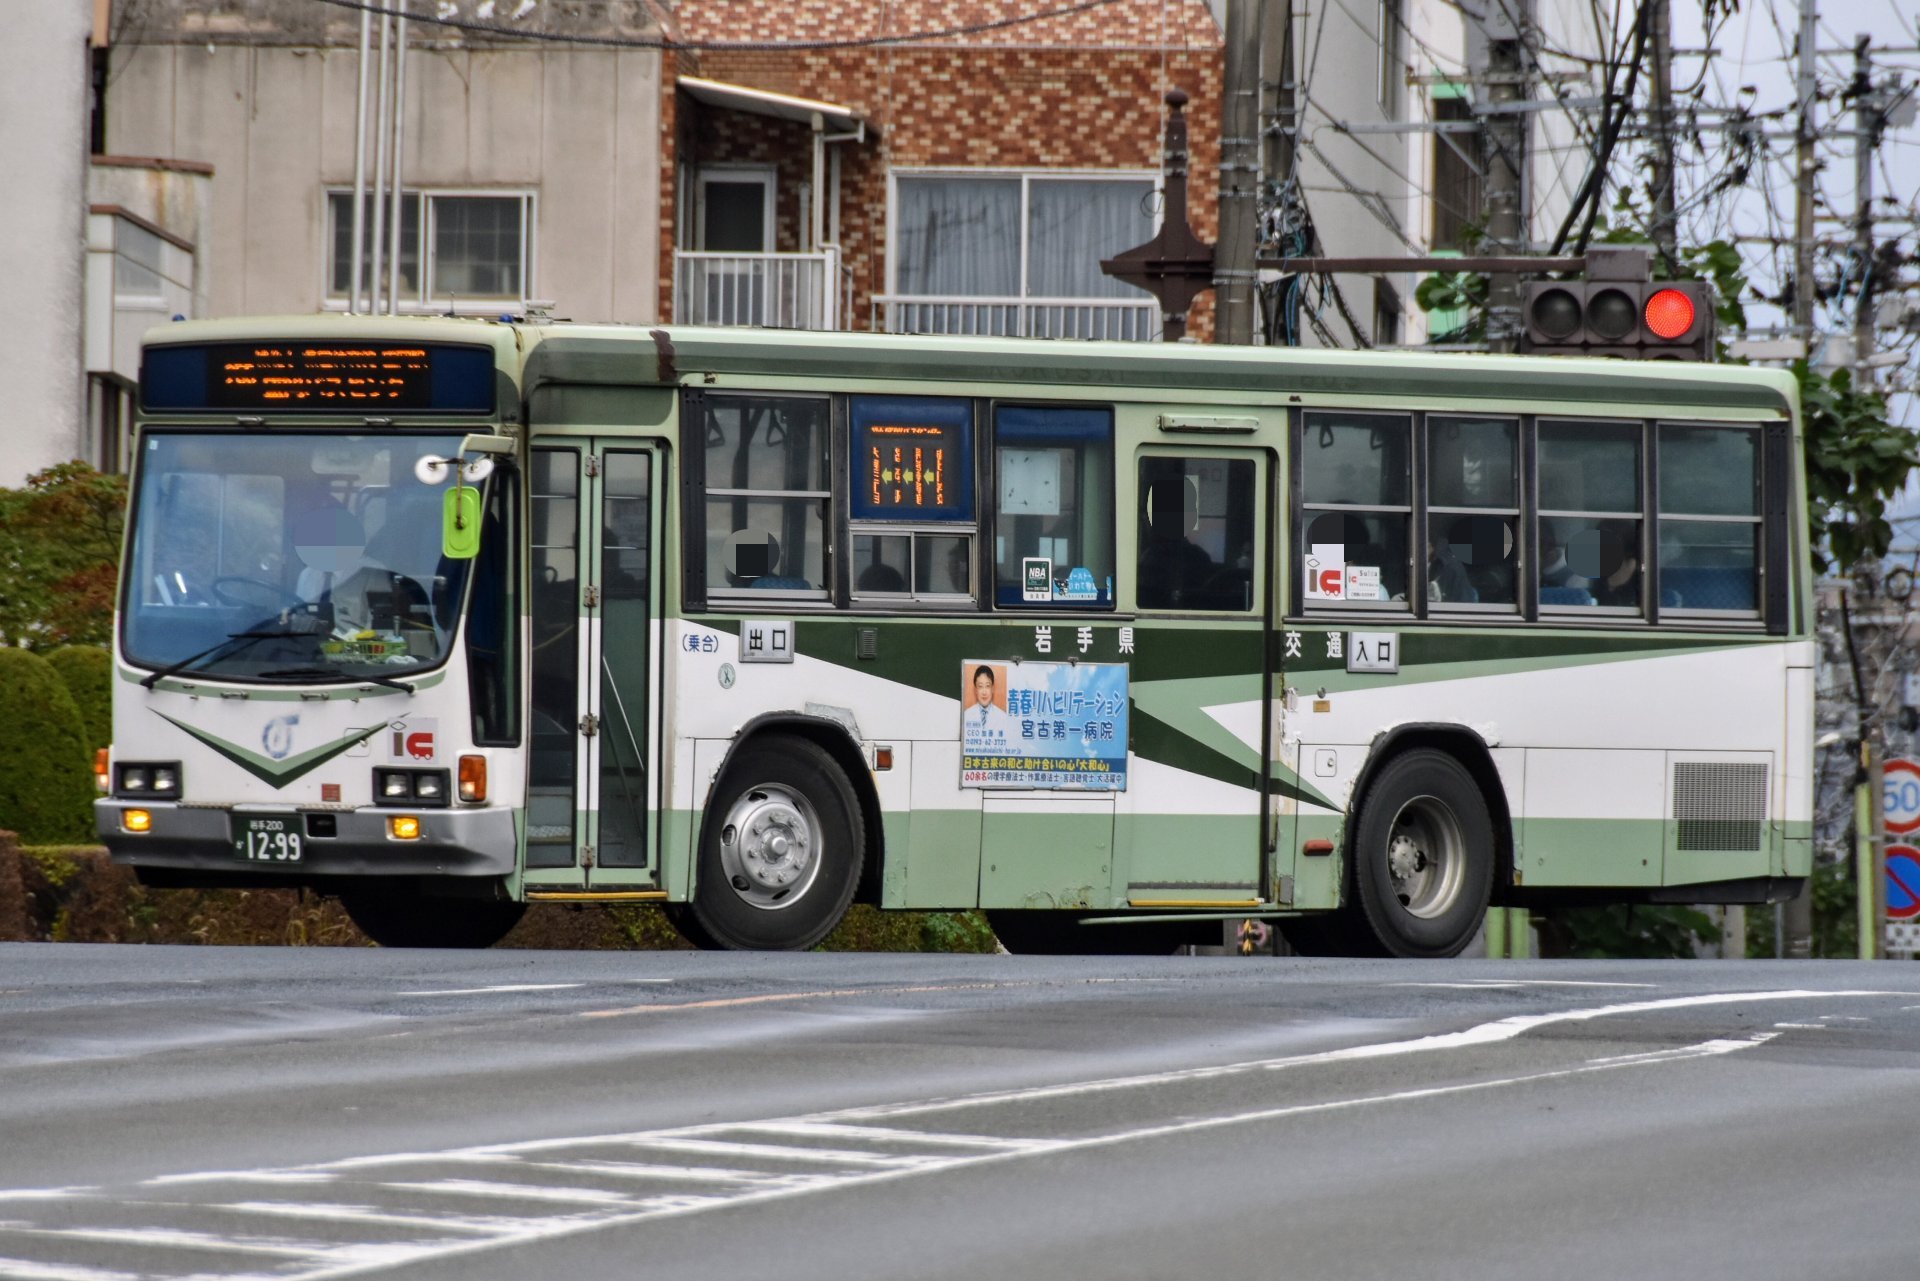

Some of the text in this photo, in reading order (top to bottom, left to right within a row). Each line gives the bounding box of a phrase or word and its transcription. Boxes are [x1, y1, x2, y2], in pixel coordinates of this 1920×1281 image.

[1028, 567, 1046, 579] NBA
[682, 634, 719, 653] (乗合)
[749, 628, 786, 650] 出口
[1035, 625, 1343, 658] 岩手県 交通
[1356, 640, 1391, 663] 入口
[1007, 688, 1125, 716] 青春リハビリテーション
[966, 729, 980, 737] CEO
[1021, 719, 1113, 742] 宮古第一病院
[1884, 780, 1920, 812] 50
[247, 831, 301, 861] 12-99
